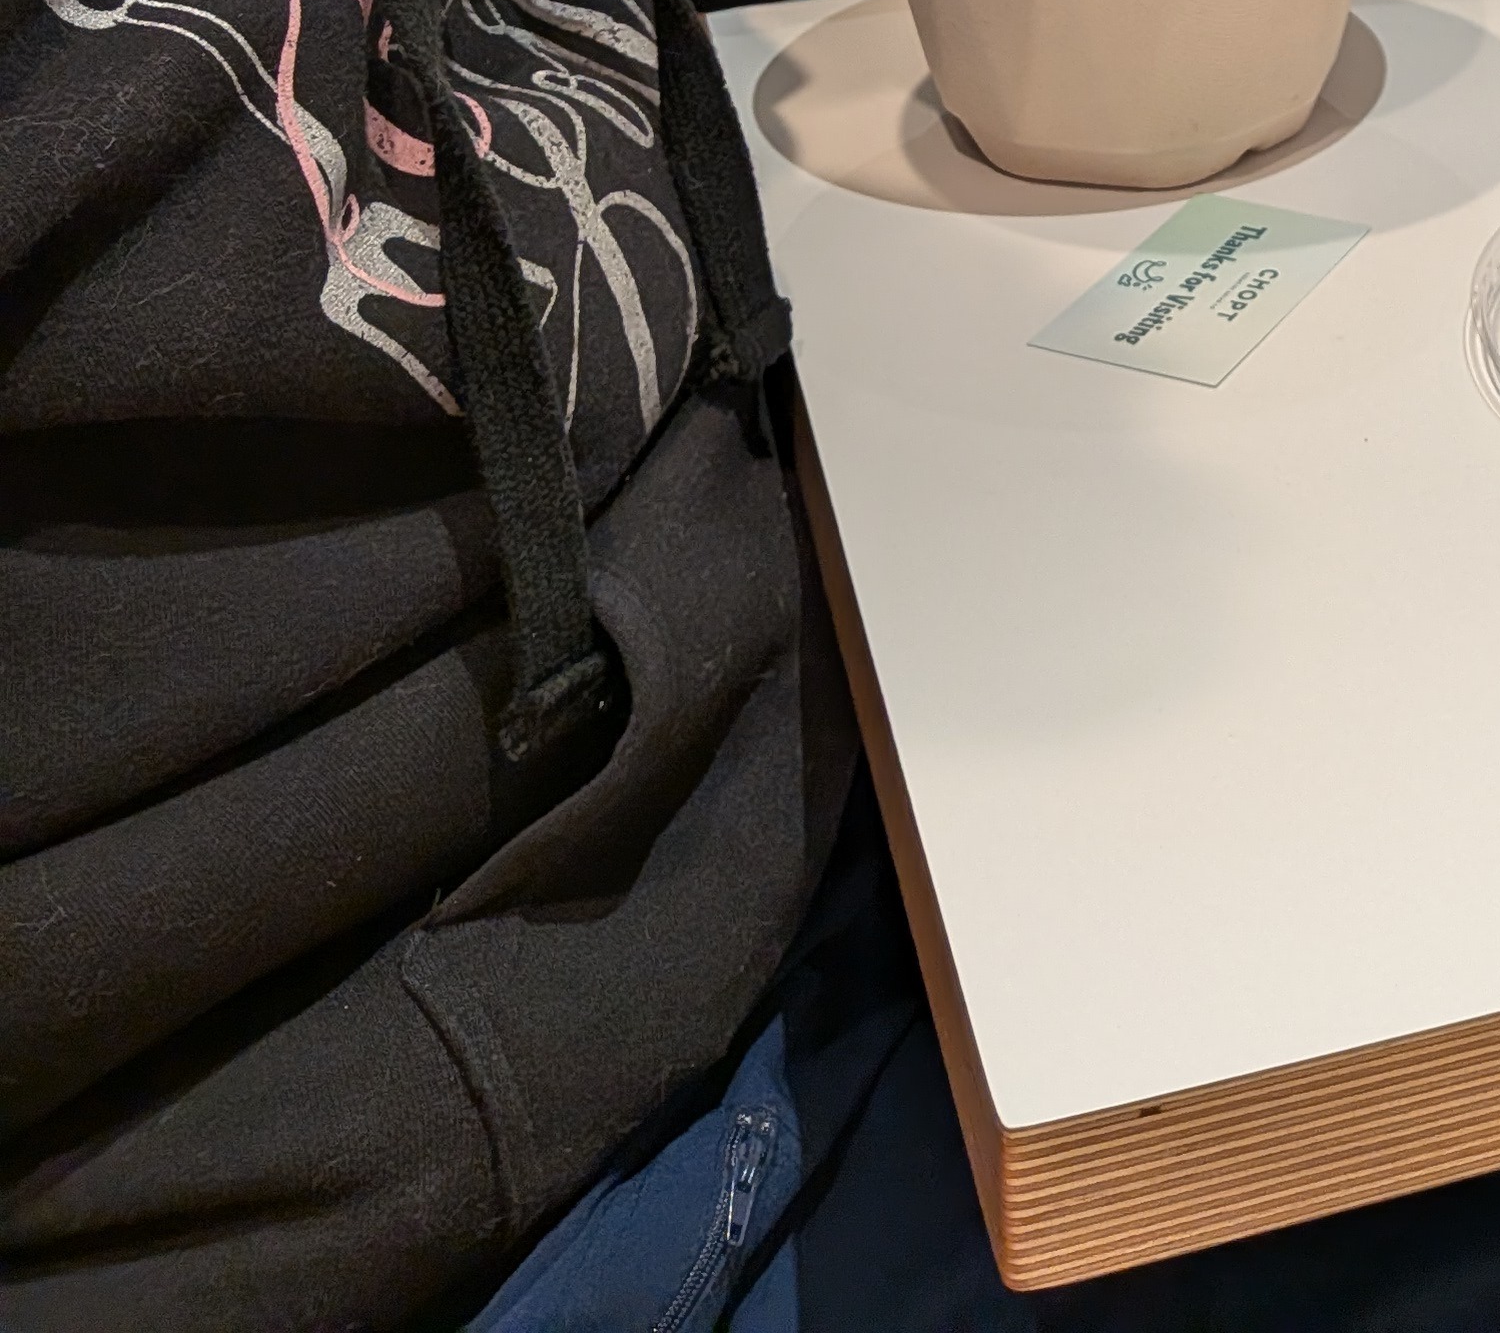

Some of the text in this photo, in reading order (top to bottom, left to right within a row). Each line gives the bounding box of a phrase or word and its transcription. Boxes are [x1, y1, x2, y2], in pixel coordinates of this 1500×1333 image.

[1201, 225, 1269, 270] Thanks
[1179, 271, 1218, 293] for
[1217, 268, 1280, 322] CHOPT
[1114, 294, 1196, 345] Visiting
